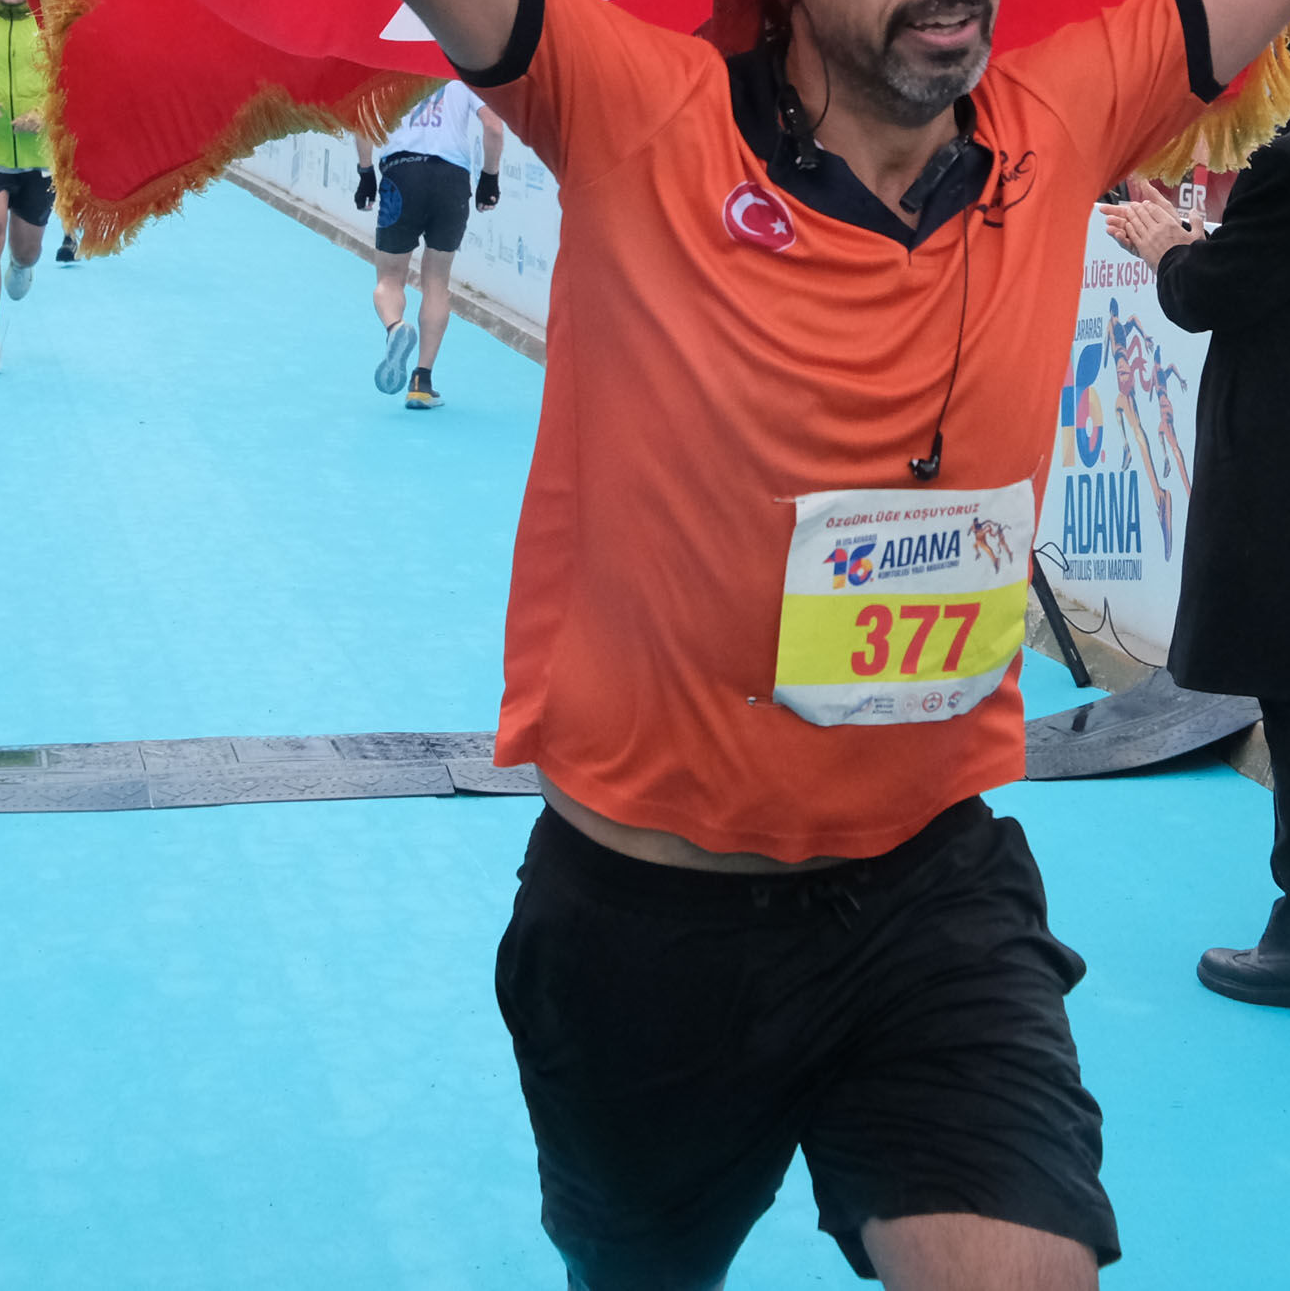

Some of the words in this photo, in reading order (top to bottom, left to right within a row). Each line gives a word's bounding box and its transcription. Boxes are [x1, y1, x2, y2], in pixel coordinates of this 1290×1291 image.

[1179, 182, 1207, 210] GR
[825, 510, 900, 529] ÖZGÜRLÜĞE
[903, 502, 981, 522] KOŞUYORUZ
[1062, 470, 1142, 554] ADANA
[879, 529, 961, 570] ADANA
[1107, 559, 1143, 581] MARATONU
[851, 602, 981, 677] 377
